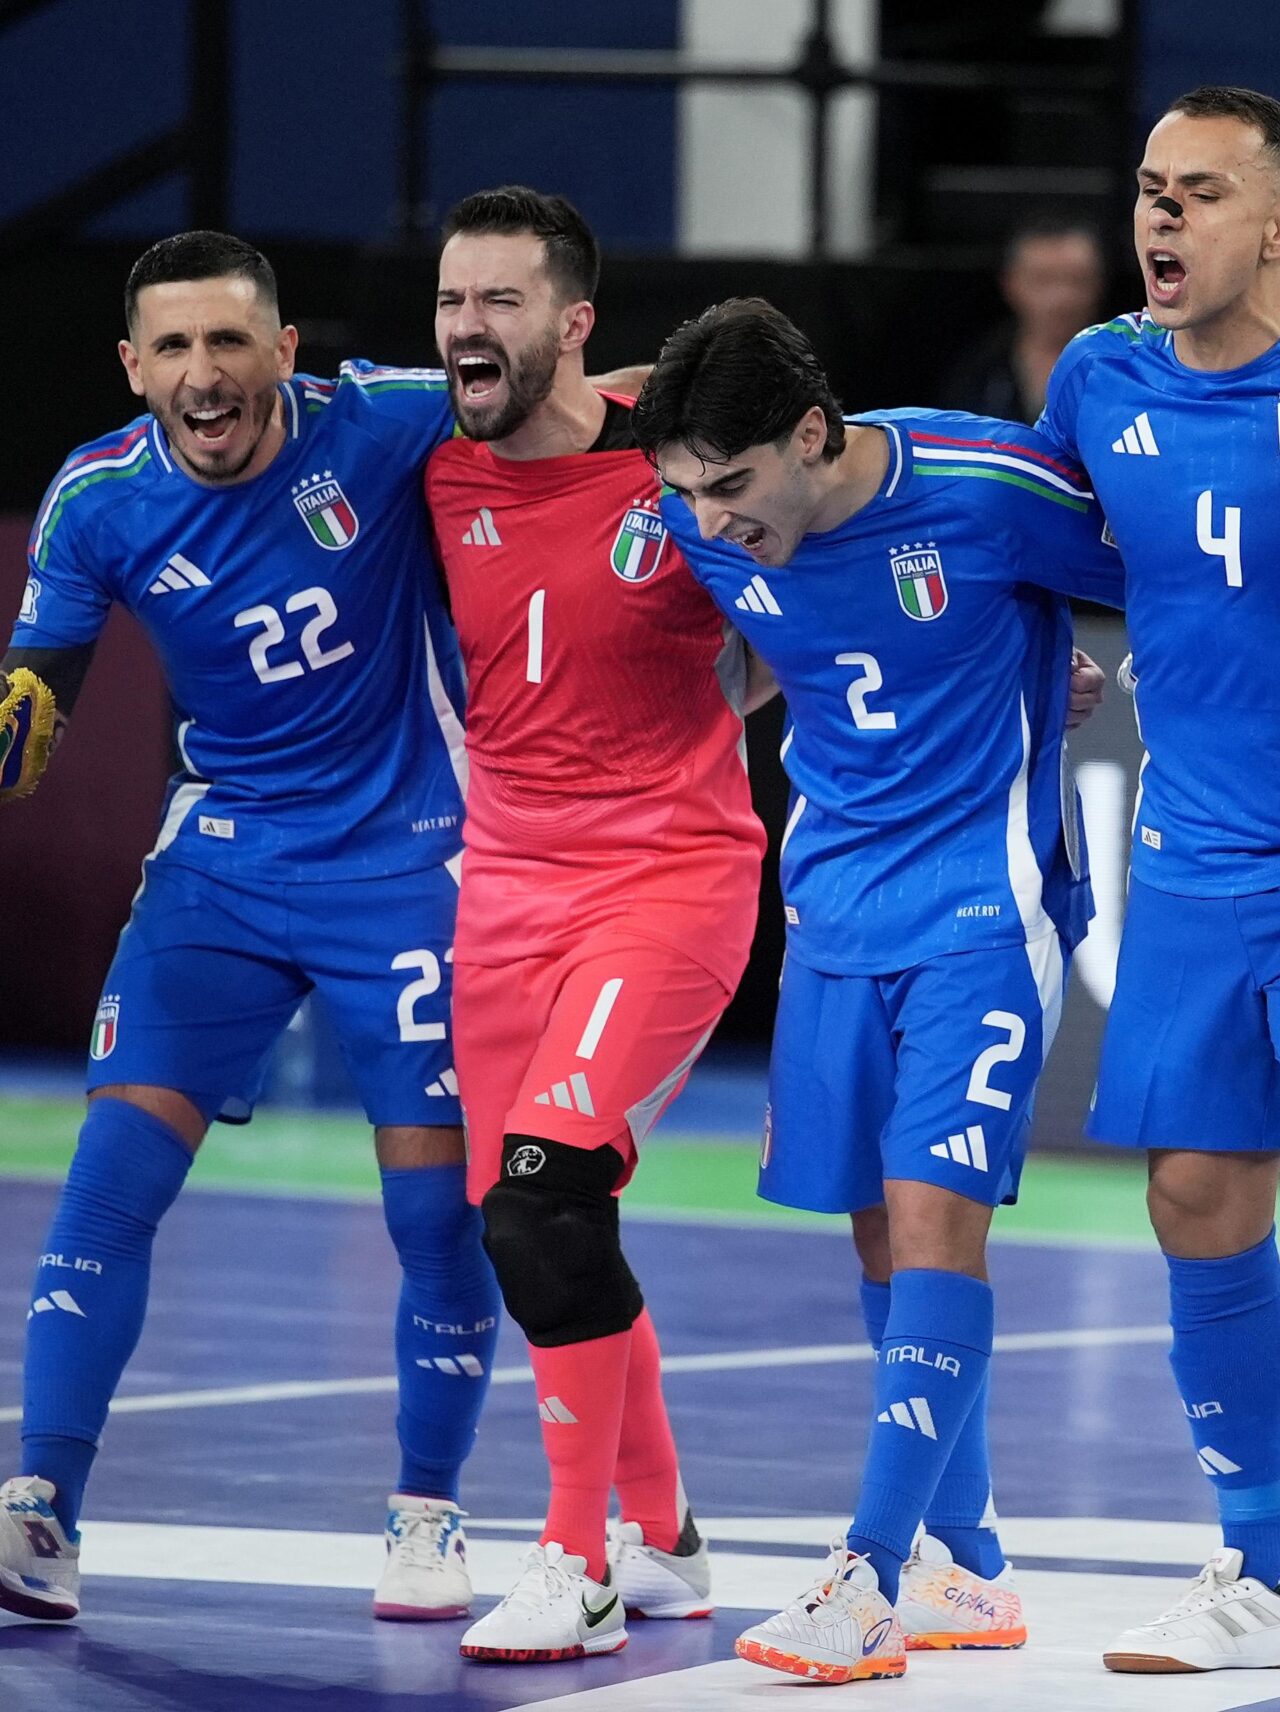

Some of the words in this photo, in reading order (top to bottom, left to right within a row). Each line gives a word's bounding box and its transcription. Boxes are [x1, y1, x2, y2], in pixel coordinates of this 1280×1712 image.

[299, 486, 338, 513] ITALIA
[626, 513, 662, 536] ITALIA
[895, 556, 936, 576] ITALIA
[1197, 491, 1242, 586] 4
[235, 588, 353, 684] 22
[527, 590, 546, 683] 1
[836, 653, 896, 730] 2
[957, 905, 1000, 917] HEAT.RDY
[391, 948, 454, 1042] 2
[576, 978, 623, 1060] 1
[967, 1010, 1026, 1110] 2
[413, 1315, 496, 1335] ITALIA
[886, 1345, 961, 1378] ITALIA
